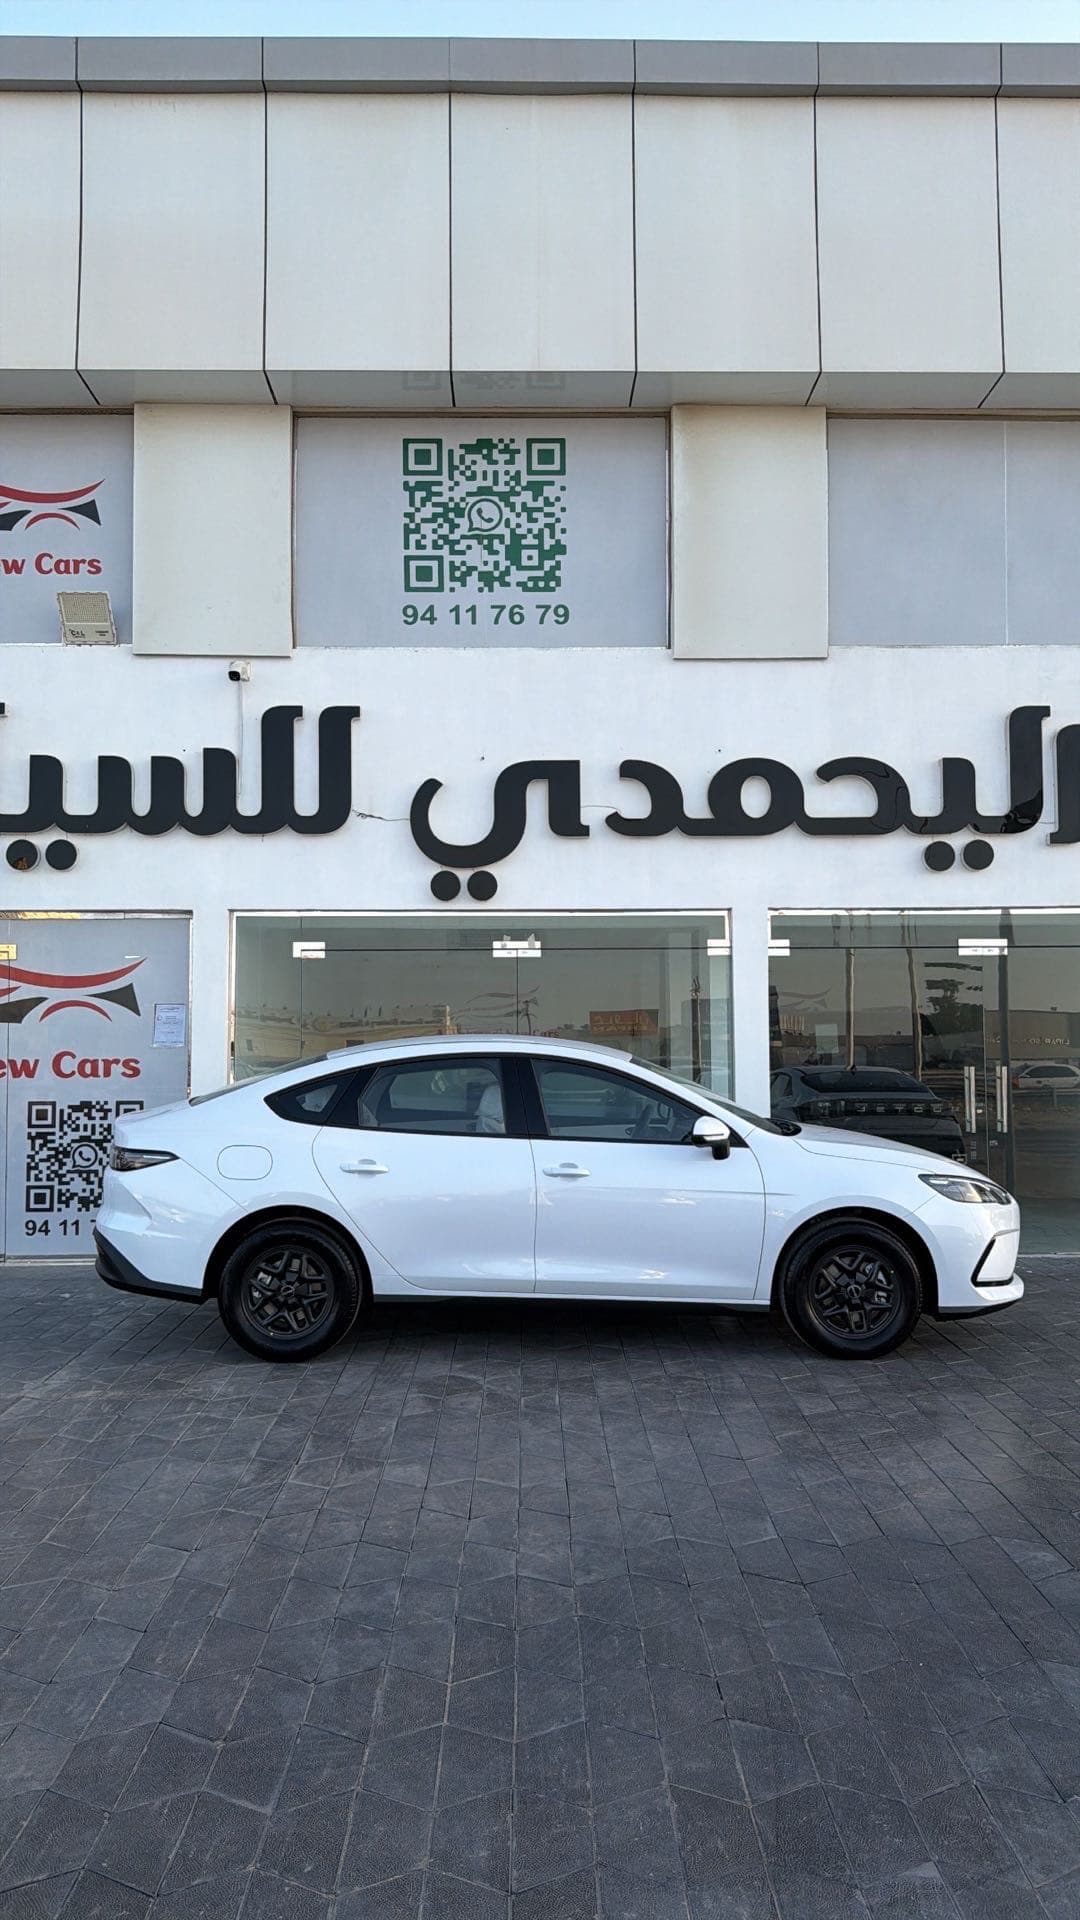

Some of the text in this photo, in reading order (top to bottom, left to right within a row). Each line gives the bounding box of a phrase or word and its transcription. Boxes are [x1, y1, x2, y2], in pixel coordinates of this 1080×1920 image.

[35, 552, 102, 575] Cars
[402, 604, 570, 625] 94 11 76 79
[410, 706, 1080, 901] اليحمدي
[52, 1050, 141, 1078] Cars
[25, 1219, 80, 1236] 94 11
